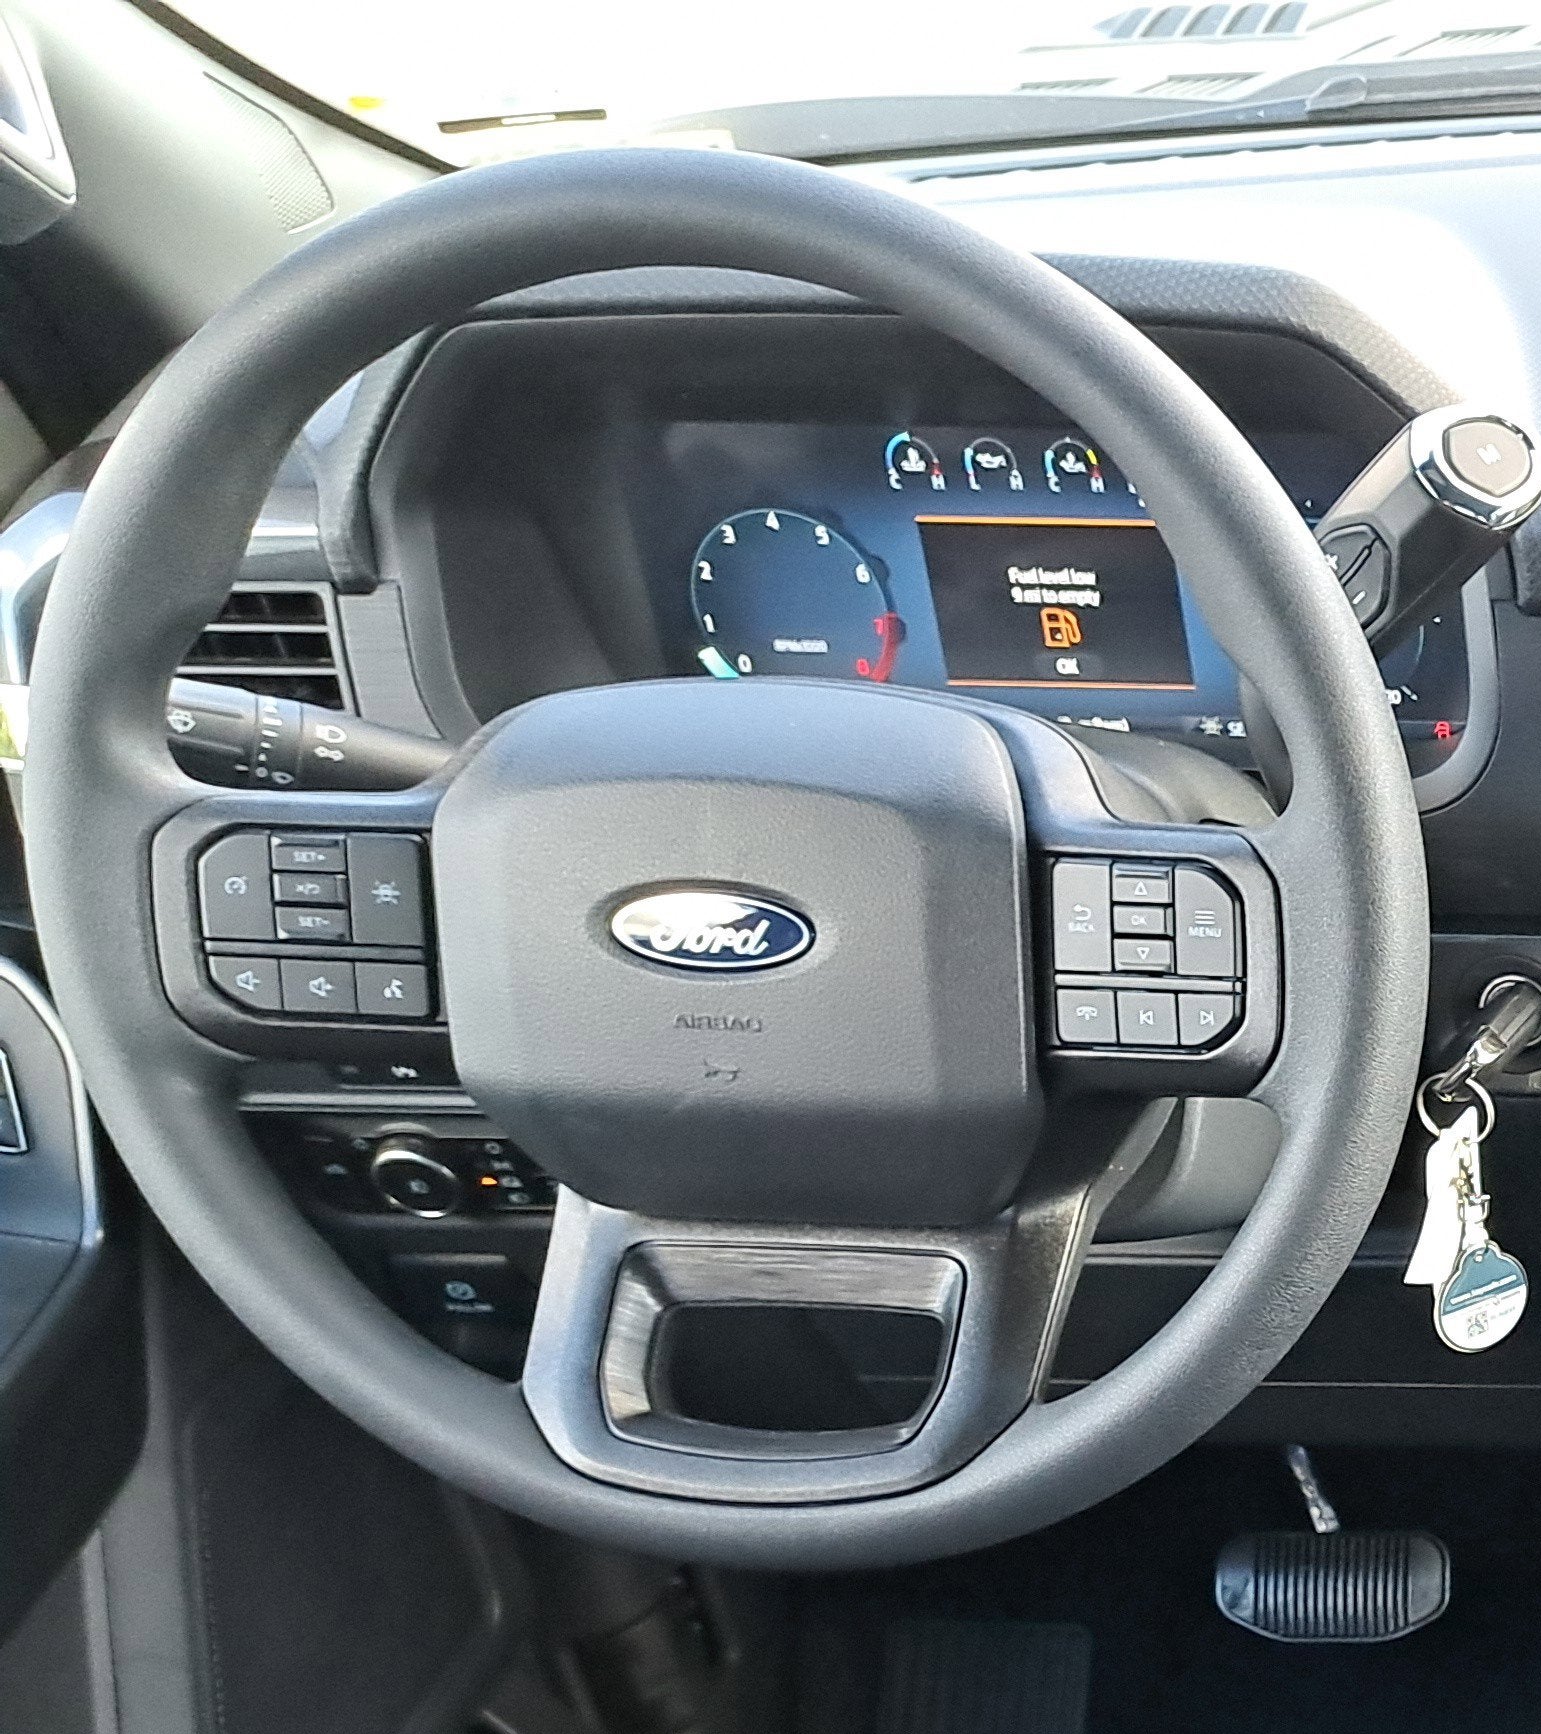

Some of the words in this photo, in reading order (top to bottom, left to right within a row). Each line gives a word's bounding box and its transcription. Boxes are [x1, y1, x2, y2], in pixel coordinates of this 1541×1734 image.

[720, 524, 737, 544] 3
[699, 561, 713, 581] 2
[737, 654, 752, 673] 0
[1187, 926, 1222, 938] MENU
